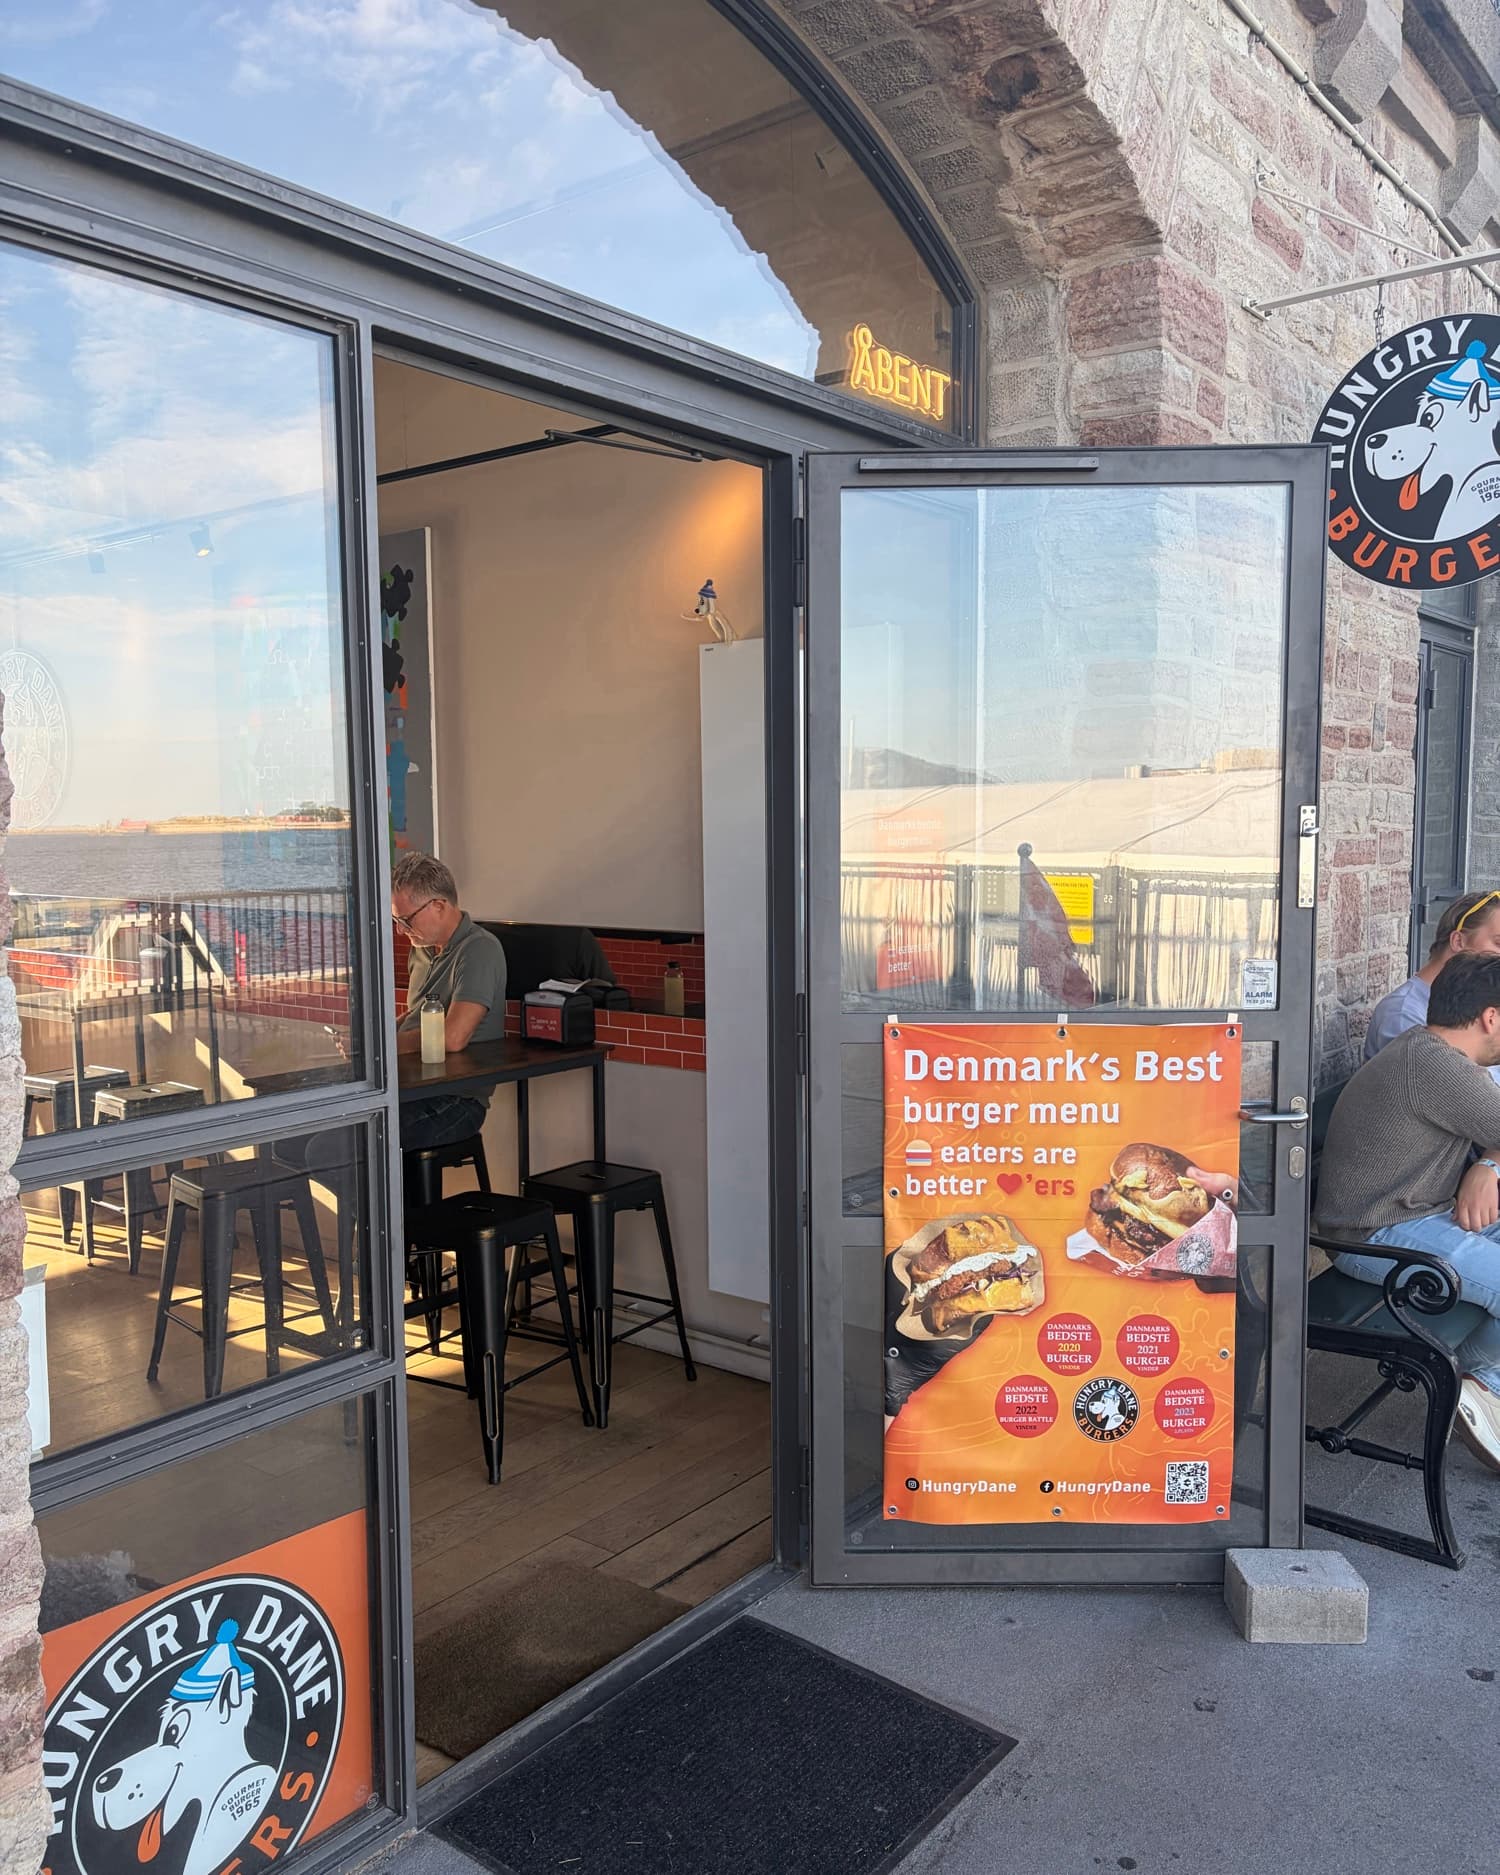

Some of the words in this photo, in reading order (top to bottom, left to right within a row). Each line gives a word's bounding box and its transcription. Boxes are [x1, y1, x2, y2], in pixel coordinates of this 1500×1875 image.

[854, 327, 951, 417] ÅBENT
[1328, 506, 1500, 584] BURGE
[888, 961, 912, 974] better
[904, 1049, 1121, 1083] Denmark's
[1134, 1050, 1224, 1083] Best
[903, 1096, 1019, 1129] burger
[1028, 1102, 1120, 1125] menu
[940, 1143, 1025, 1164] eaters
[1034, 1146, 1077, 1165] are
[905, 1174, 988, 1196] better
[1047, 1323, 1092, 1331] DANMARKS
[1047, 1331, 1092, 1341] BEDSTE
[1126, 1333, 1170, 1343] BEDSTE
[1058, 1343, 1081, 1352] 2020
[1137, 1345, 1159, 1354] 2021
[1046, 1354, 1092, 1363] BURGER
[1126, 1356, 1170, 1365] BURGER
[1005, 1394, 1049, 1404] BEDSTE
[1075, 1379, 1114, 1410] HUNGRY
[1117, 1384, 1137, 1411] DANE
[1164, 1388, 1206, 1396] DANMARKS
[1164, 1396, 1206, 1406] BEDSTE
[1015, 1406, 1038, 1415] 2022
[1078, 1417, 1134, 1440] BURGERS
[1162, 1417, 1206, 1428] BURGER
[922, 1479, 1017, 1494] HungryDane
[1056, 1480, 1151, 1495] HungryDane
[243, 1594, 332, 1720] DANE
[221, 1777, 267, 1811] GOURMET
[228, 1787, 262, 1813] BURGER
[230, 1796, 261, 1821] 1965
